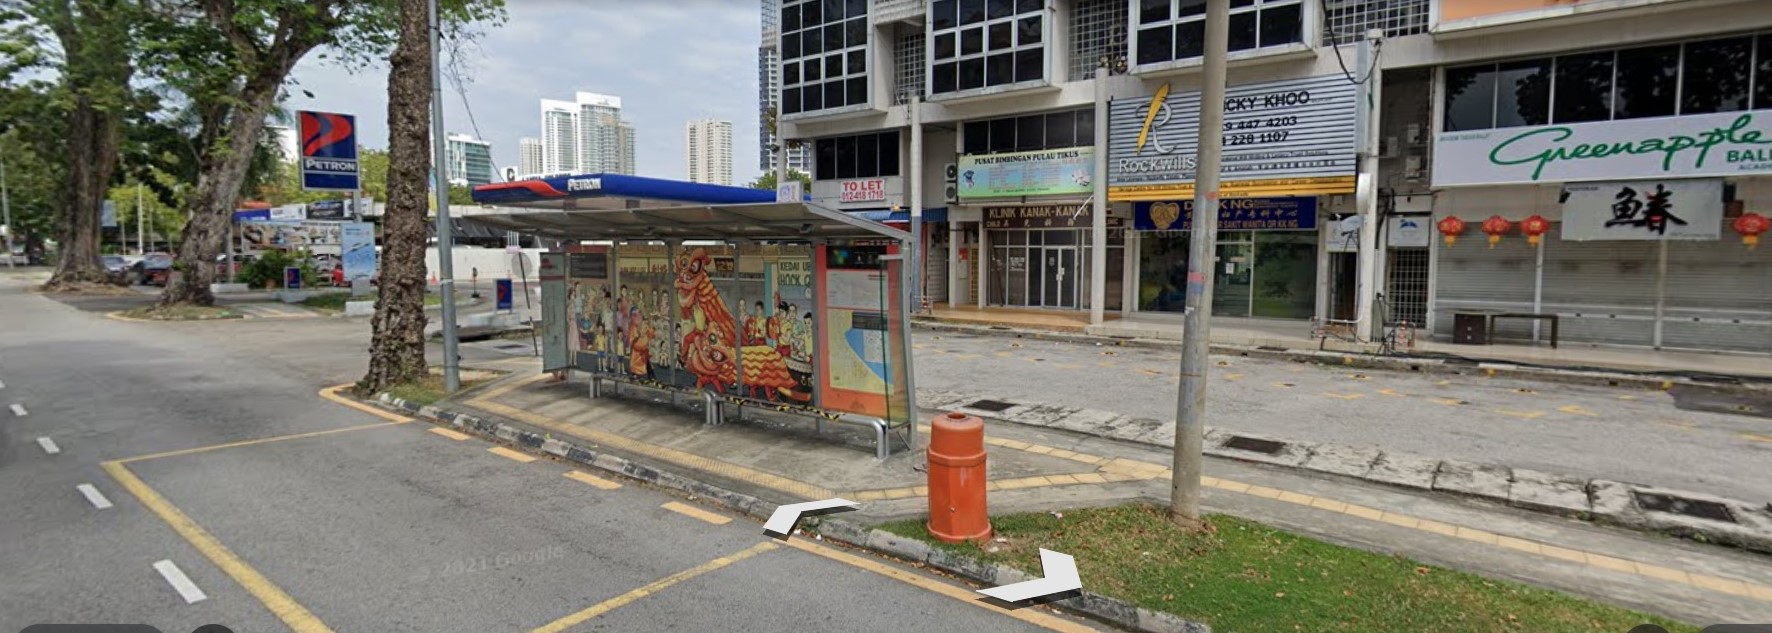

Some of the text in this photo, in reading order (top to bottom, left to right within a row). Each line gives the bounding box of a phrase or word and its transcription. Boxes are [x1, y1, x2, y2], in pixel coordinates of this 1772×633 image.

[1223, 91, 1310, 111] CKY KHOO
[1222, 116, 1297, 131] 9 447 4203
[1231, 134, 1254, 146] 228
[1260, 132, 1289, 143] 1107
[1488, 114, 1772, 181] Greenapple
[975, 157, 994, 165] PUSAT
[995, 154, 1031, 163] BIMBINGAN
[1033, 152, 1055, 161] PULAU
[1057, 150, 1079, 159] TIKUS
[1728, 149, 1772, 162] BAL
[306, 159, 355, 170] PETRON
[1119, 154, 1197, 173] Rockwills
[843, 181, 882, 192] TO LET
[1230, 199, 1254, 209] NG
[990, 206, 1089, 218] KLINIK KANAK-KANAK
[780, 262, 799, 271] KEDAI
